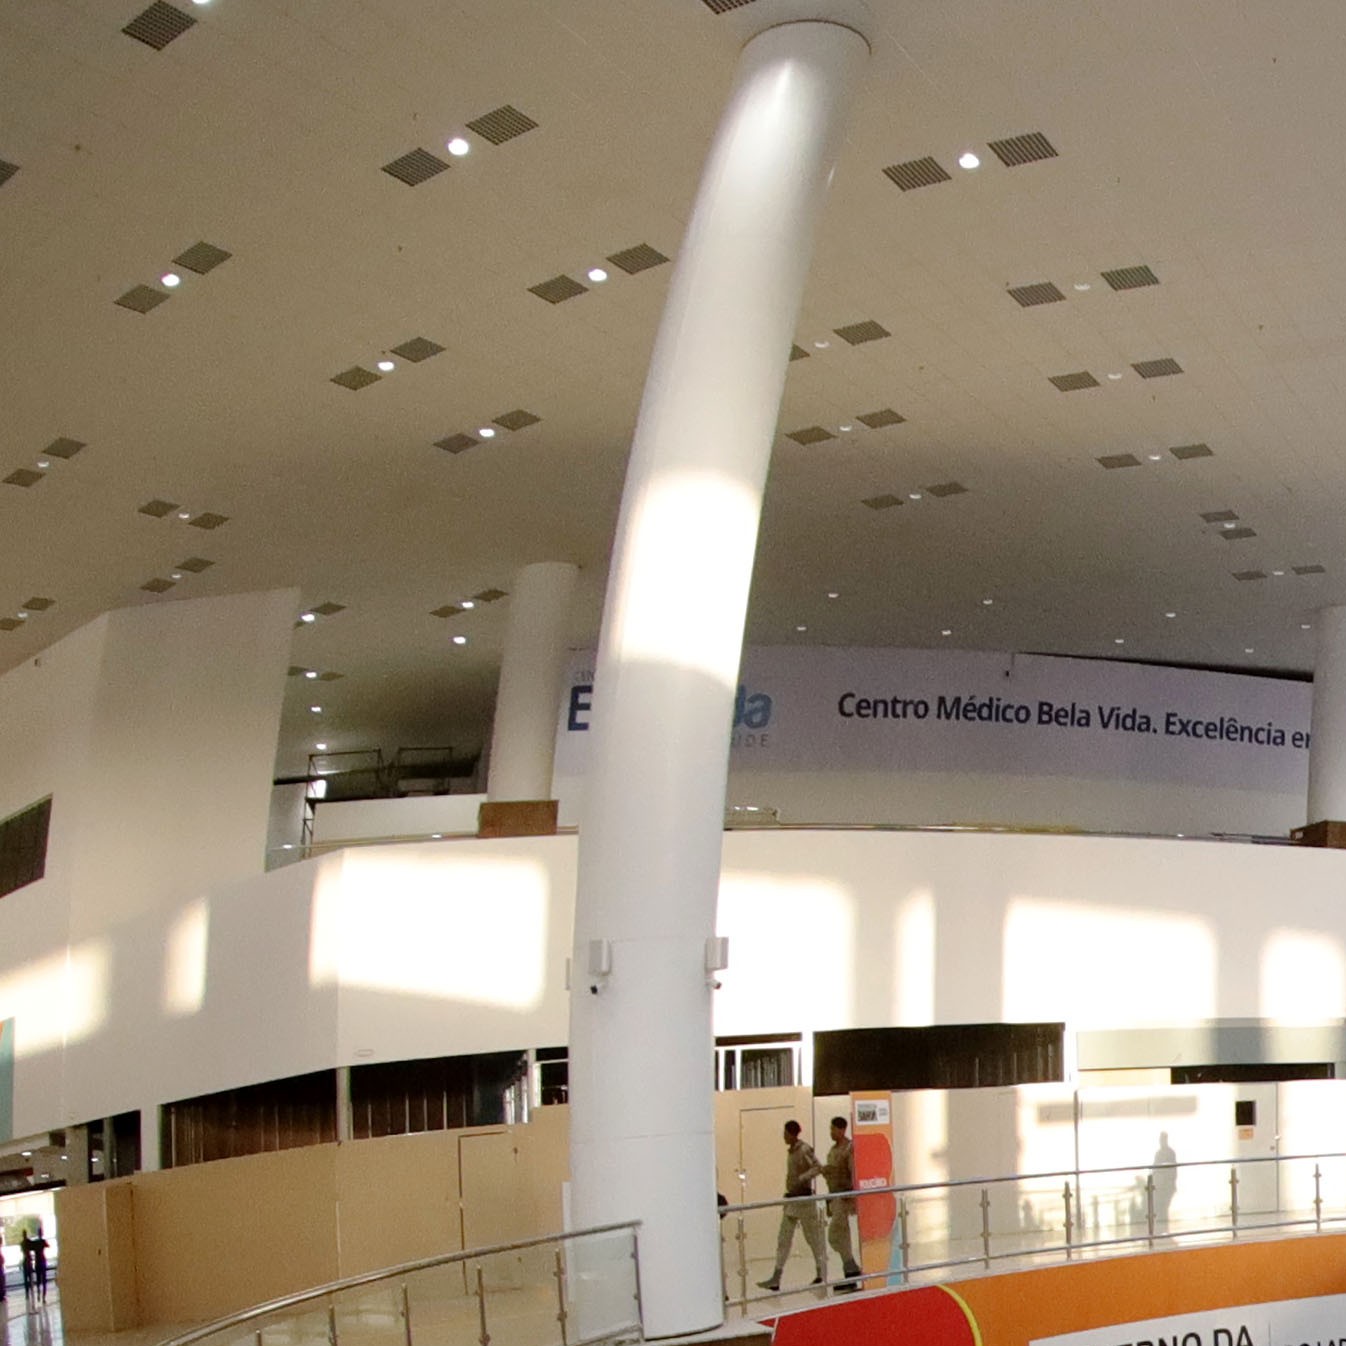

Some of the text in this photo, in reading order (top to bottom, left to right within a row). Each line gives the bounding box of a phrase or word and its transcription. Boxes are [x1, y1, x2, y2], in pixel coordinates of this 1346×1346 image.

[838, 691, 929, 719] Centro
[936, 695, 1031, 724] Médico
[1036, 701, 1091, 728] Bela
[1098, 705, 1157, 734] Vida.
[1164, 711, 1286, 747] Excelência
